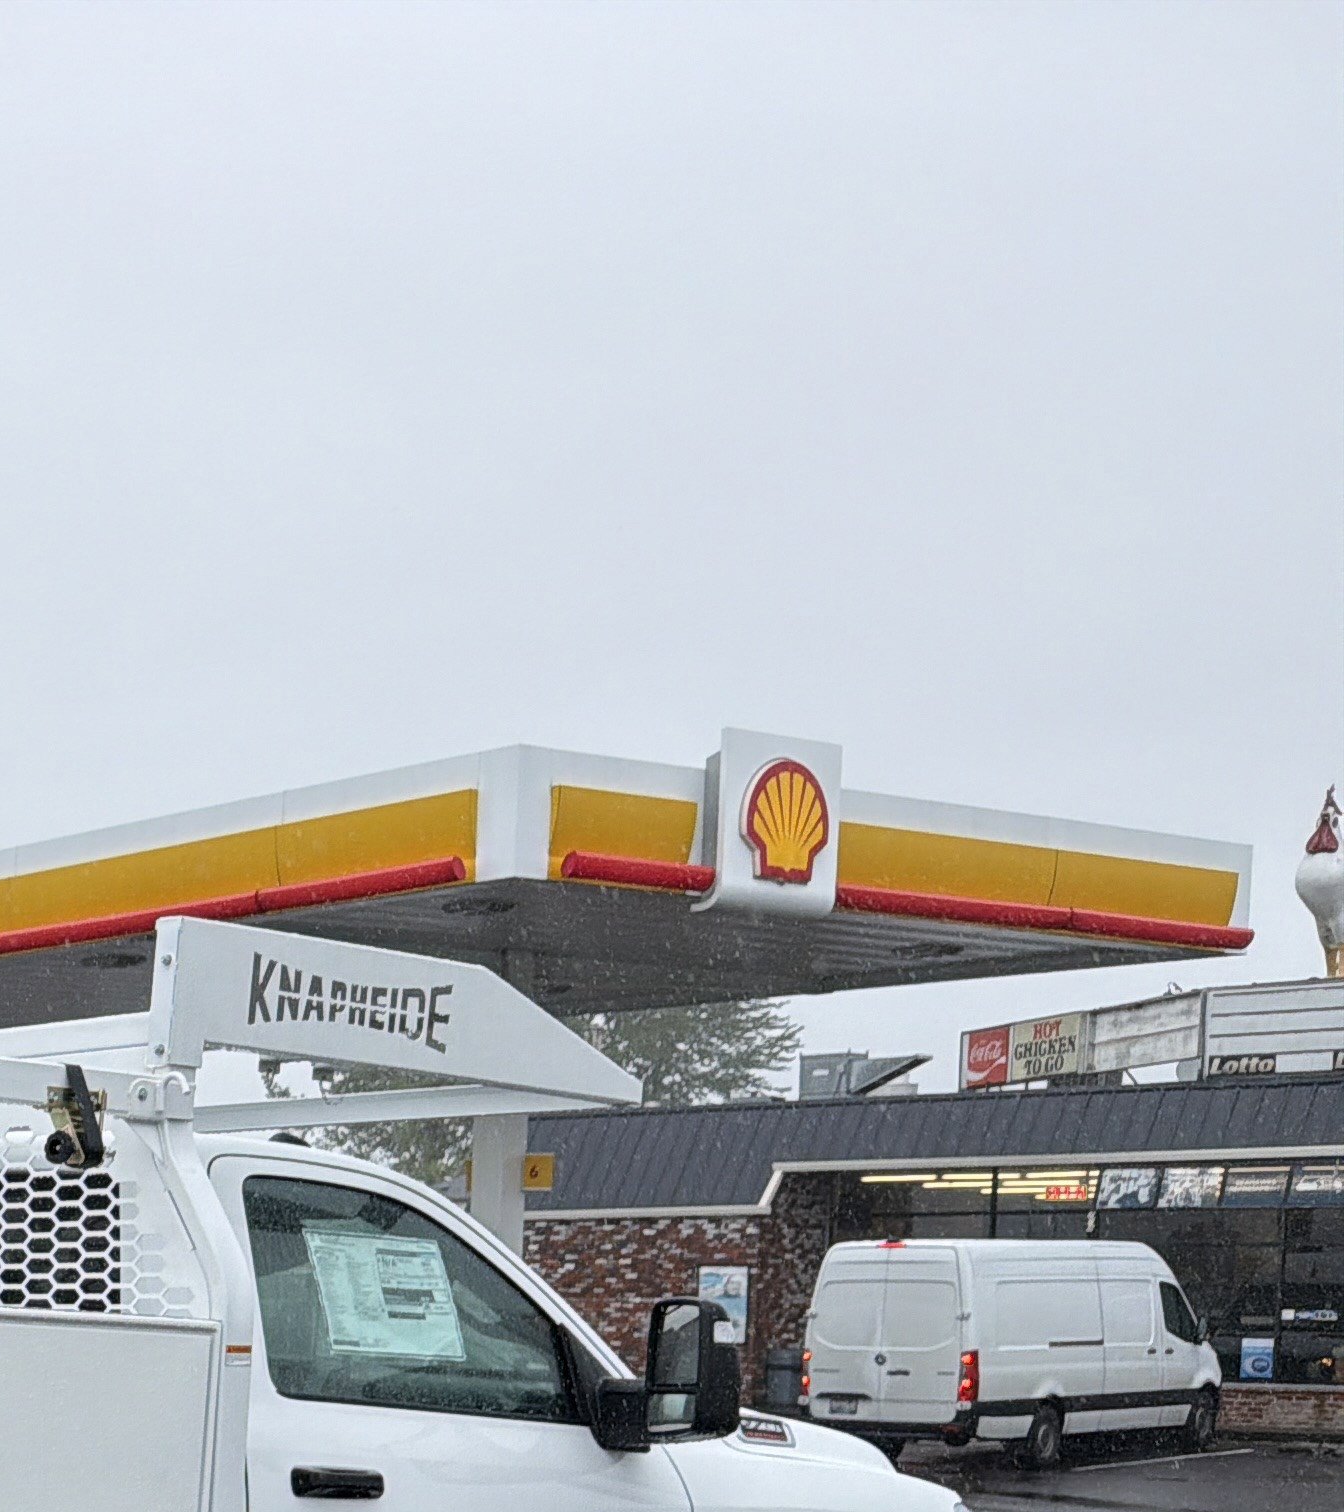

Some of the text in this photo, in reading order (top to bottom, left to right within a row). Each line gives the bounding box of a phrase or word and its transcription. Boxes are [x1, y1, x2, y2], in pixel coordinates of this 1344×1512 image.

[246, 951, 454, 1055] KNAPHEIDE
[1032, 1019, 1062, 1040] HOT
[1014, 1035, 1077, 1060] CHICKEN
[1024, 1054, 1065, 1077] TO GO
[1209, 1056, 1275, 1075] Lotto
[529, 1165, 539, 1180] 6
